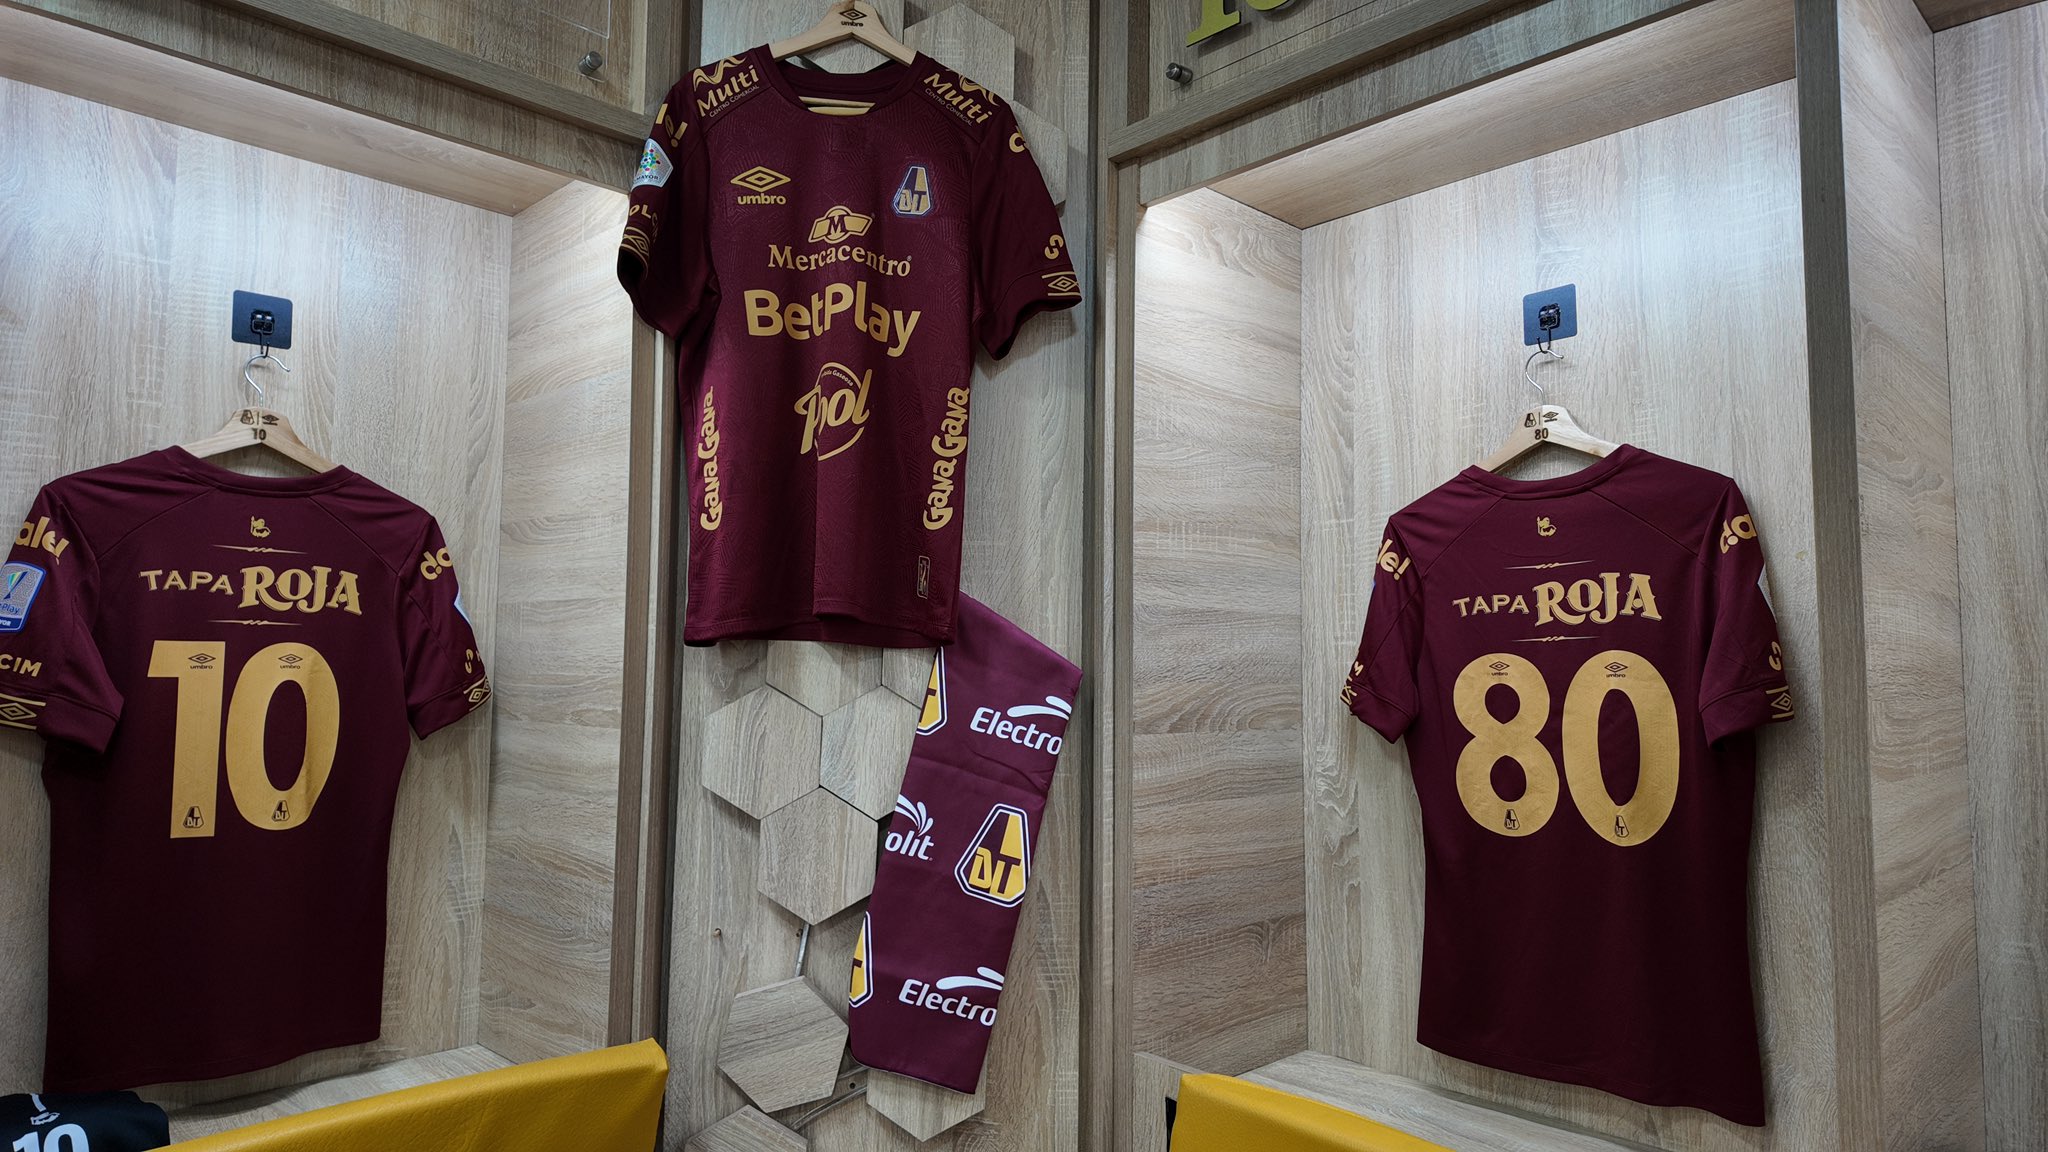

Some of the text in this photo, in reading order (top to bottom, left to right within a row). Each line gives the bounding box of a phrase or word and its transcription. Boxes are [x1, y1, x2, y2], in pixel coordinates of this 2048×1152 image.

[697, 65, 759, 117] Multi
[710, 101, 730, 117] CENTRO
[923, 73, 993, 123] Multi
[737, 193, 787, 205] umbro
[767, 244, 912, 277] Mercacentro
[744, 281, 922, 357] BetPlay
[251, 428, 267, 440] 10
[1535, 428, 1549, 440] 80
[139, 565, 363, 615] TAPA ROJA
[1452, 572, 1662, 627] TAPA ROJA
[147, 640, 340, 839] 10
[969, 706, 1063, 756] Electro
[1453, 650, 1680, 847] 80
[898, 978, 998, 1027] Electro
